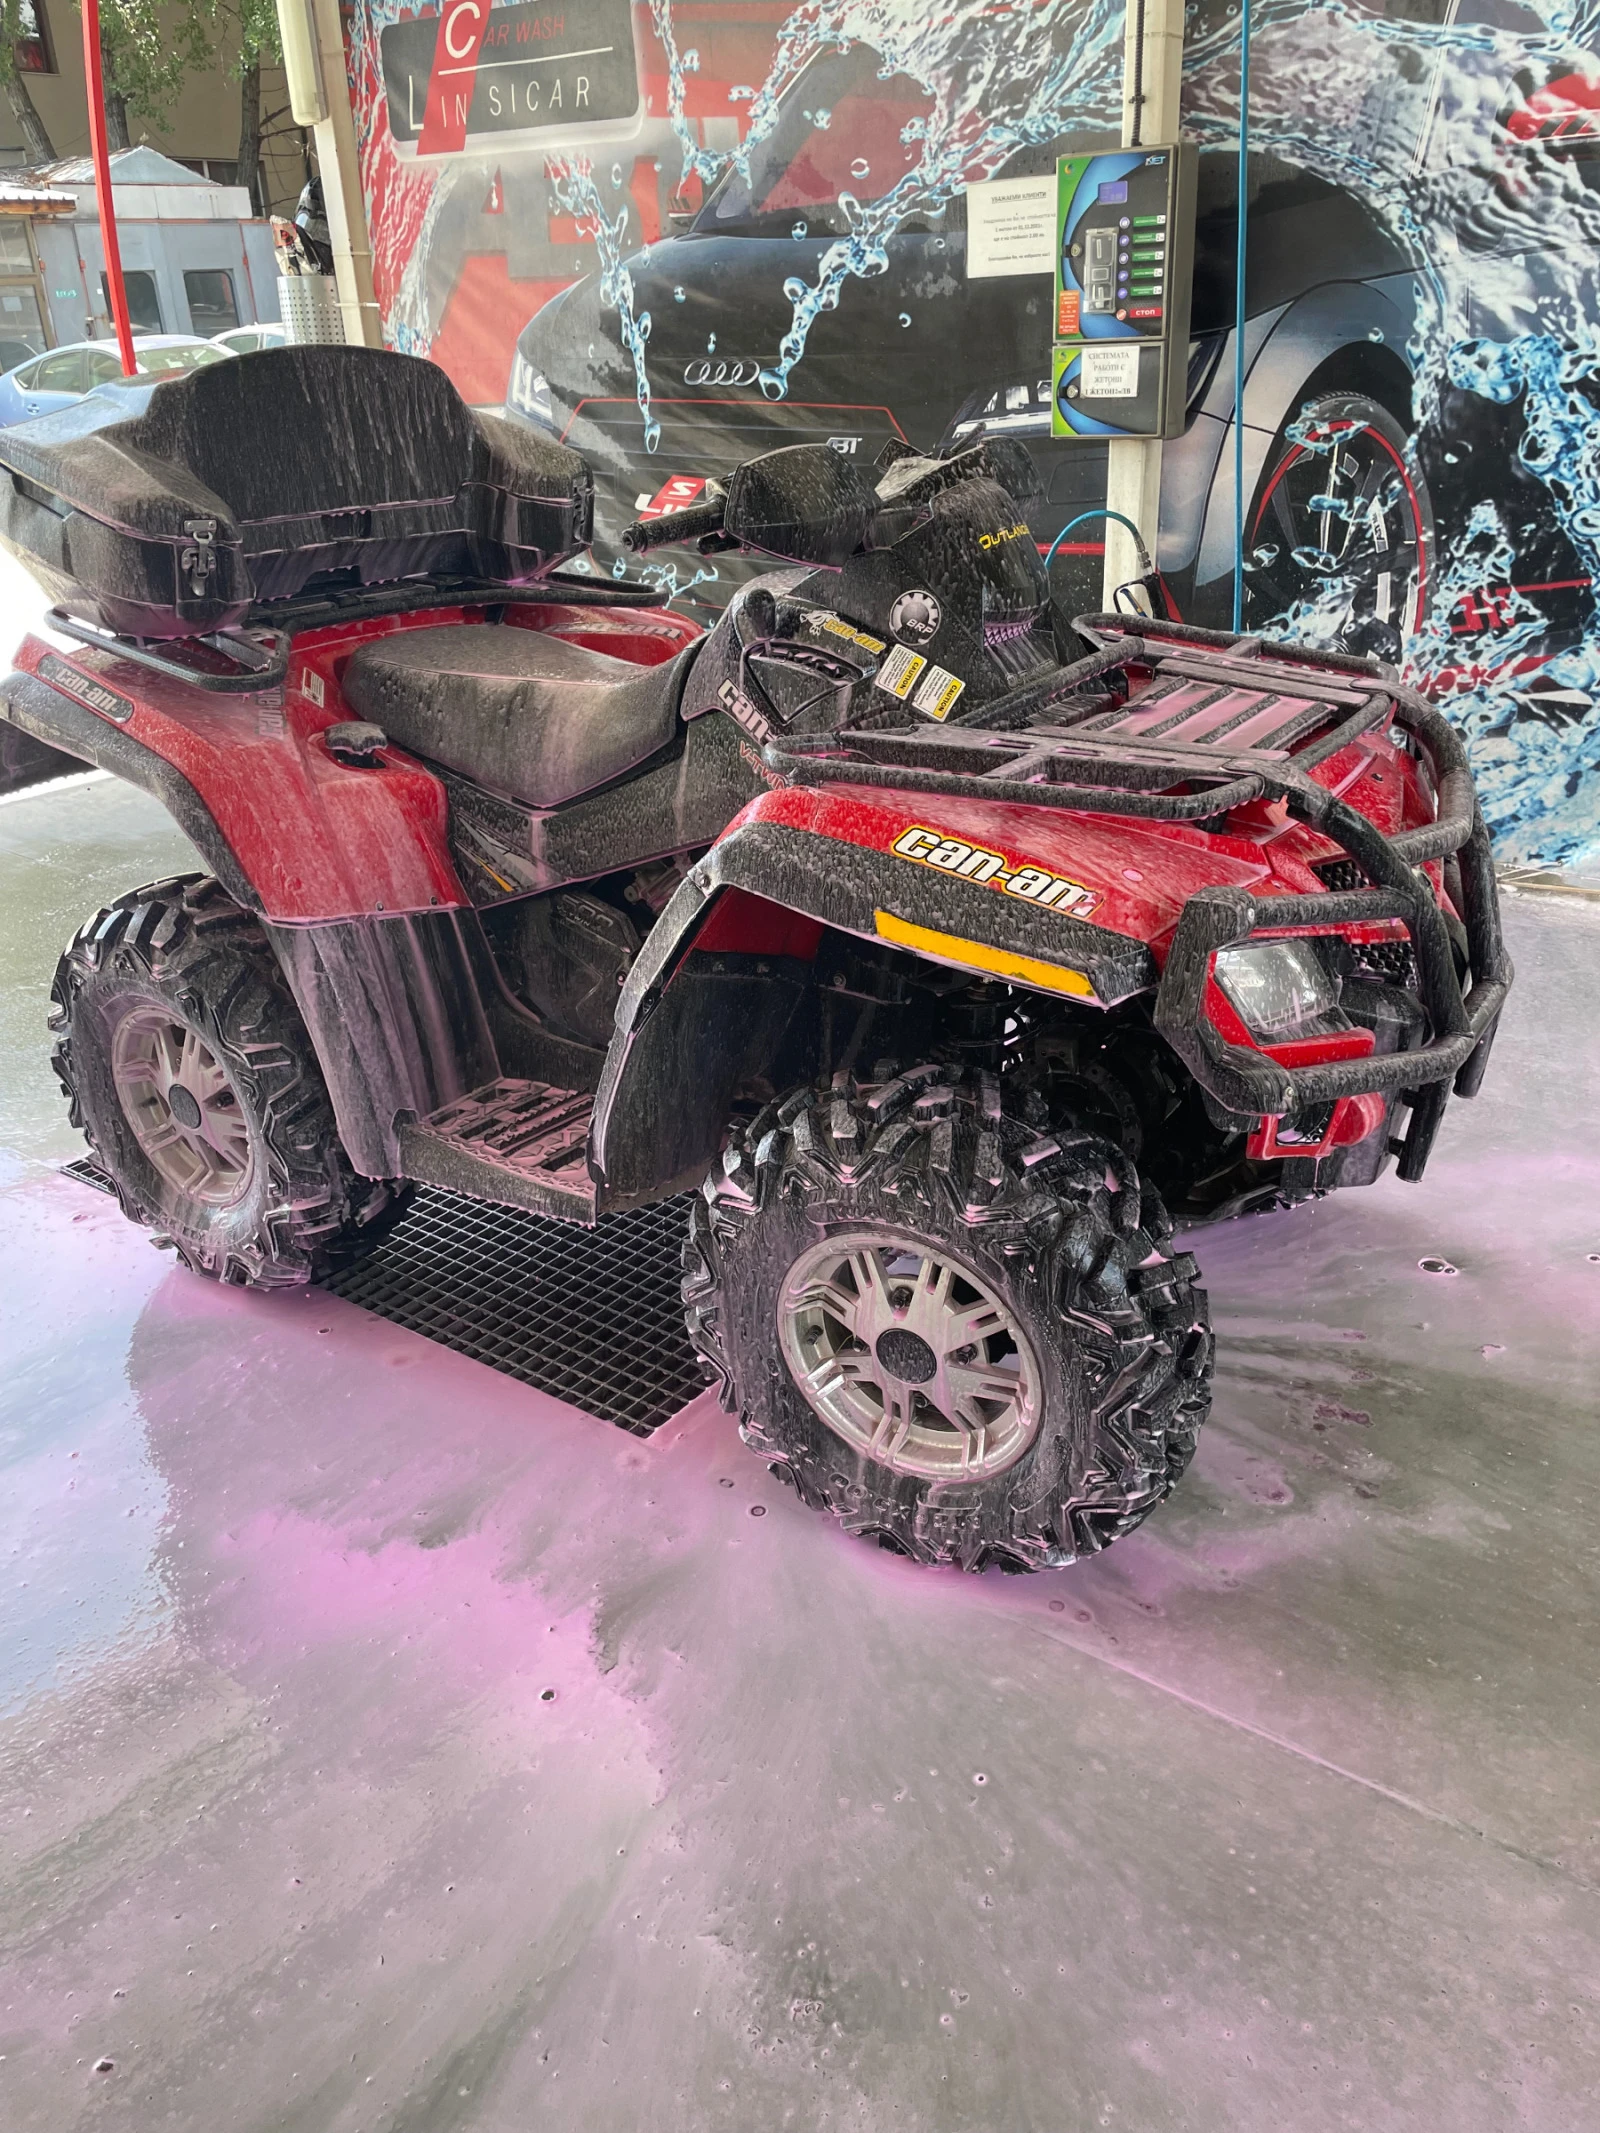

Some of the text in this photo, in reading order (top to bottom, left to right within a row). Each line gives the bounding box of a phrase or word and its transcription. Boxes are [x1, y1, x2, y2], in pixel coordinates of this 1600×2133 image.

[516, 15, 565, 43] WASH
[489, 76, 590, 116] SICAR
[1088, 352, 1130, 360] СИСТЕМАТА
[635, 493, 687, 514] LI
[825, 619, 886, 654] can-am
[906, 618, 934, 634] BRP
[56, 667, 118, 711] can-am
[900, 662, 919, 690] CAUTION
[938, 685, 957, 712] CAUTION
[892, 826, 1103, 918] can-am
